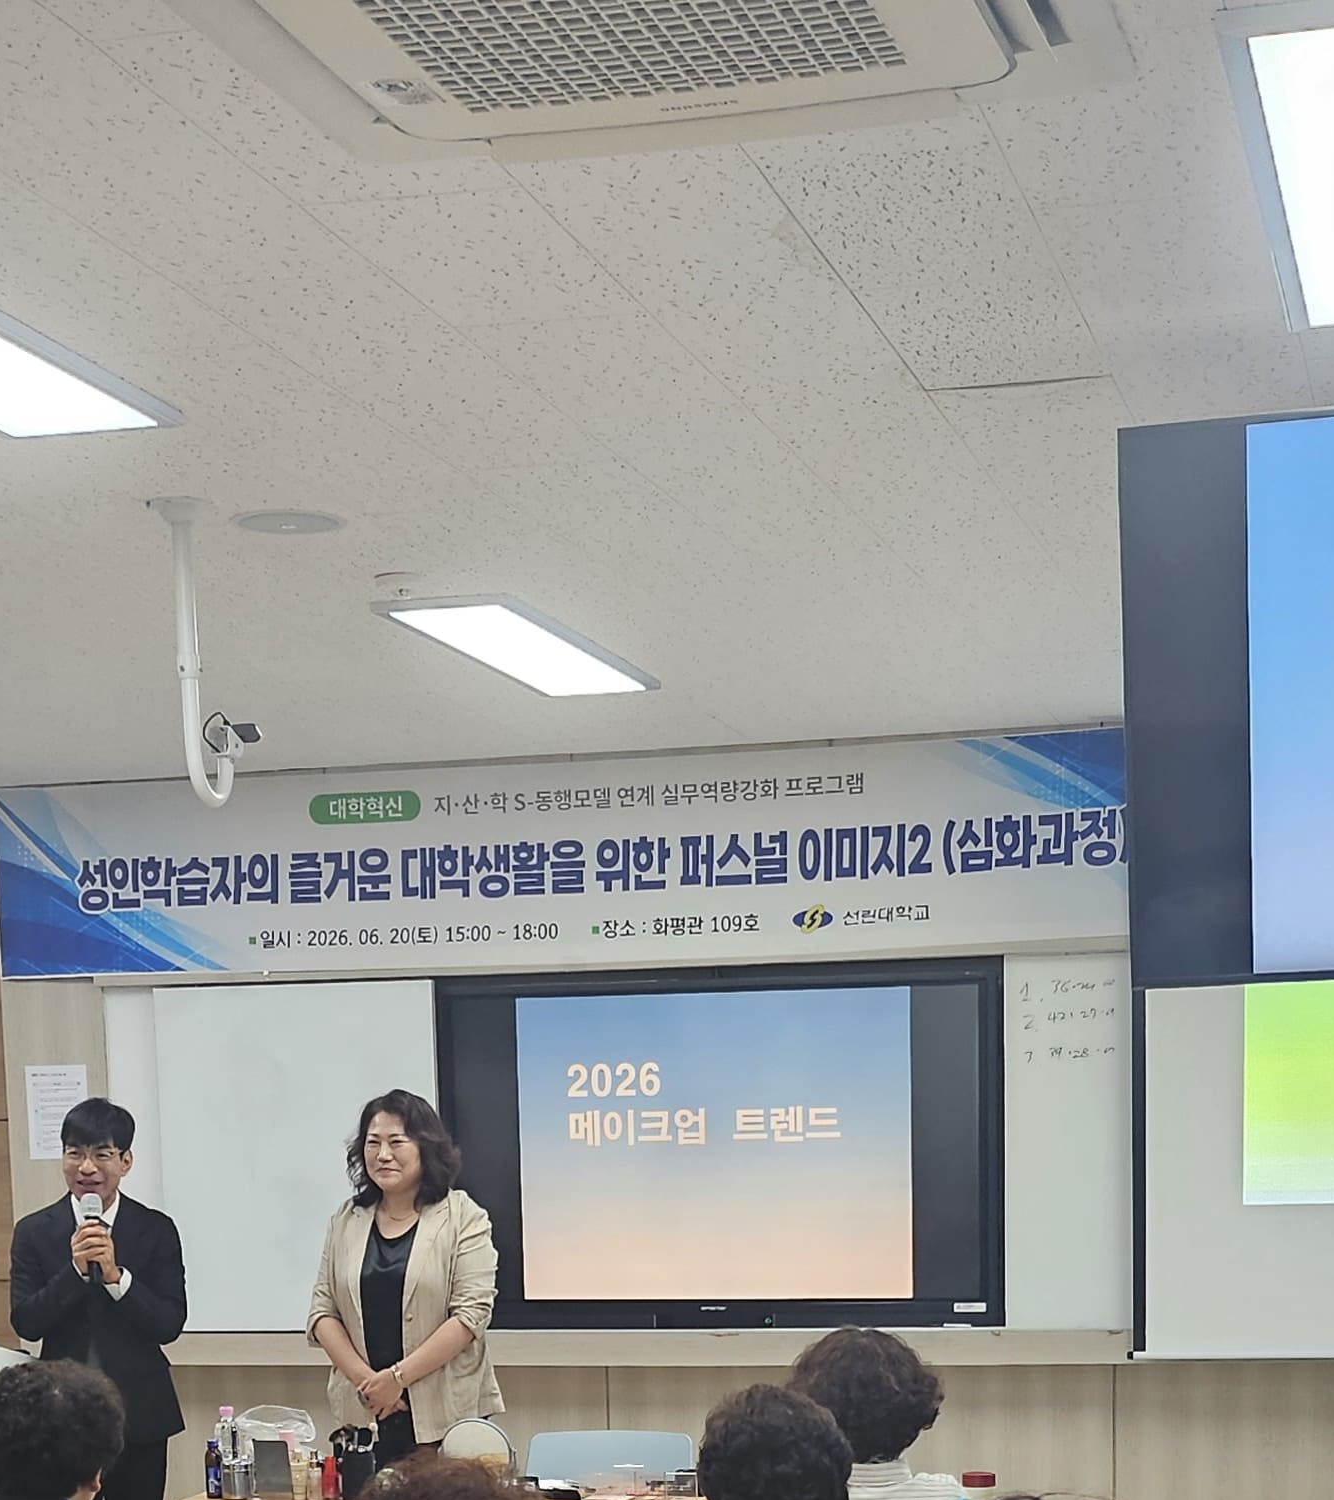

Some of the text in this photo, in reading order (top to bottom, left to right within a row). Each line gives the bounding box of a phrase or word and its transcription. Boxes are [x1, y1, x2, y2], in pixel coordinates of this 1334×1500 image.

[328, 795, 403, 820] 대학혁신
[514, 786, 611, 812] S-동행모델
[617, 783, 655, 808] 연계
[661, 777, 780, 806] 실무역량강화
[784, 771, 865, 797] 프로그램
[76, 852, 280, 913] 성인학습자의
[287, 846, 392, 905] 즐거운
[400, 838, 586, 900] 대학생활을
[595, 835, 671, 892] 위한
[679, 830, 788, 888] 퍼스널
[798, 822, 933, 882] 이미지2
[602, 918, 636, 939] 장소
[651, 915, 704, 937] 화평관
[710, 913, 760, 934] 109호
[842, 904, 930, 926] 선린대학교
[260, 929, 291, 949] 일시
[307, 929, 353, 947] 2026.
[358, 928, 384, 946] 06.
[389, 926, 438, 945] 20(토)
[445, 924, 492, 943] 15:00
[513, 922, 559, 941] 18:00
[567, 1061, 661, 1098] 2026
[568, 1105, 842, 1147] 메이크업 트렌드
